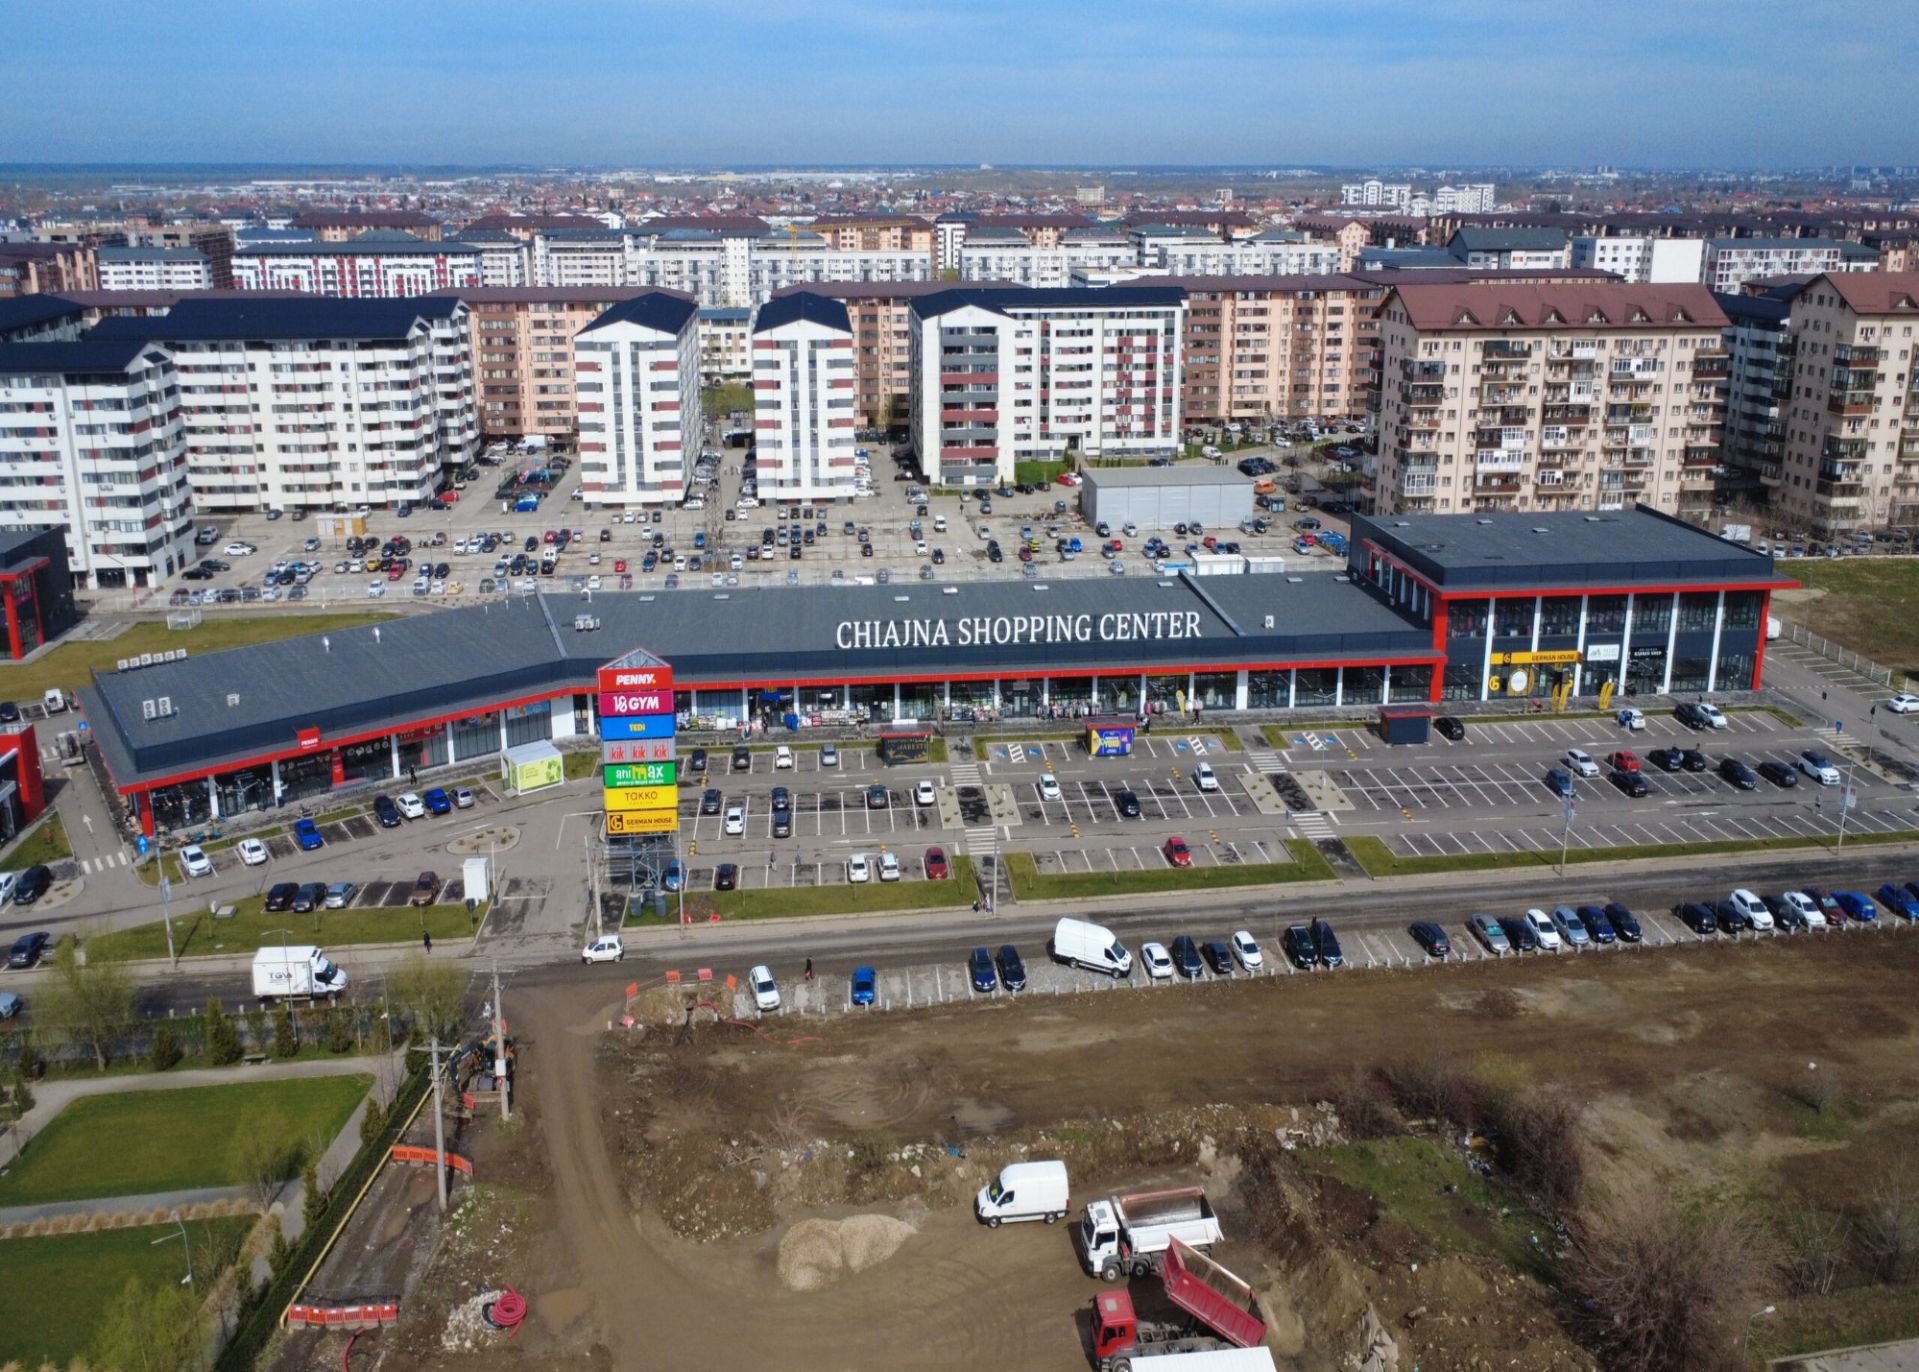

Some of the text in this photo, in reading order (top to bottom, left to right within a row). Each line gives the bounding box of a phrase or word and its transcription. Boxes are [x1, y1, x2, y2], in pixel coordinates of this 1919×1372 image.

[836, 611, 1202, 649] CHIAJNA SHOPPING CENTER
[628, 696, 660, 711] GYM
[615, 764, 664, 780] animax
[626, 818, 653, 826] GERMAN
